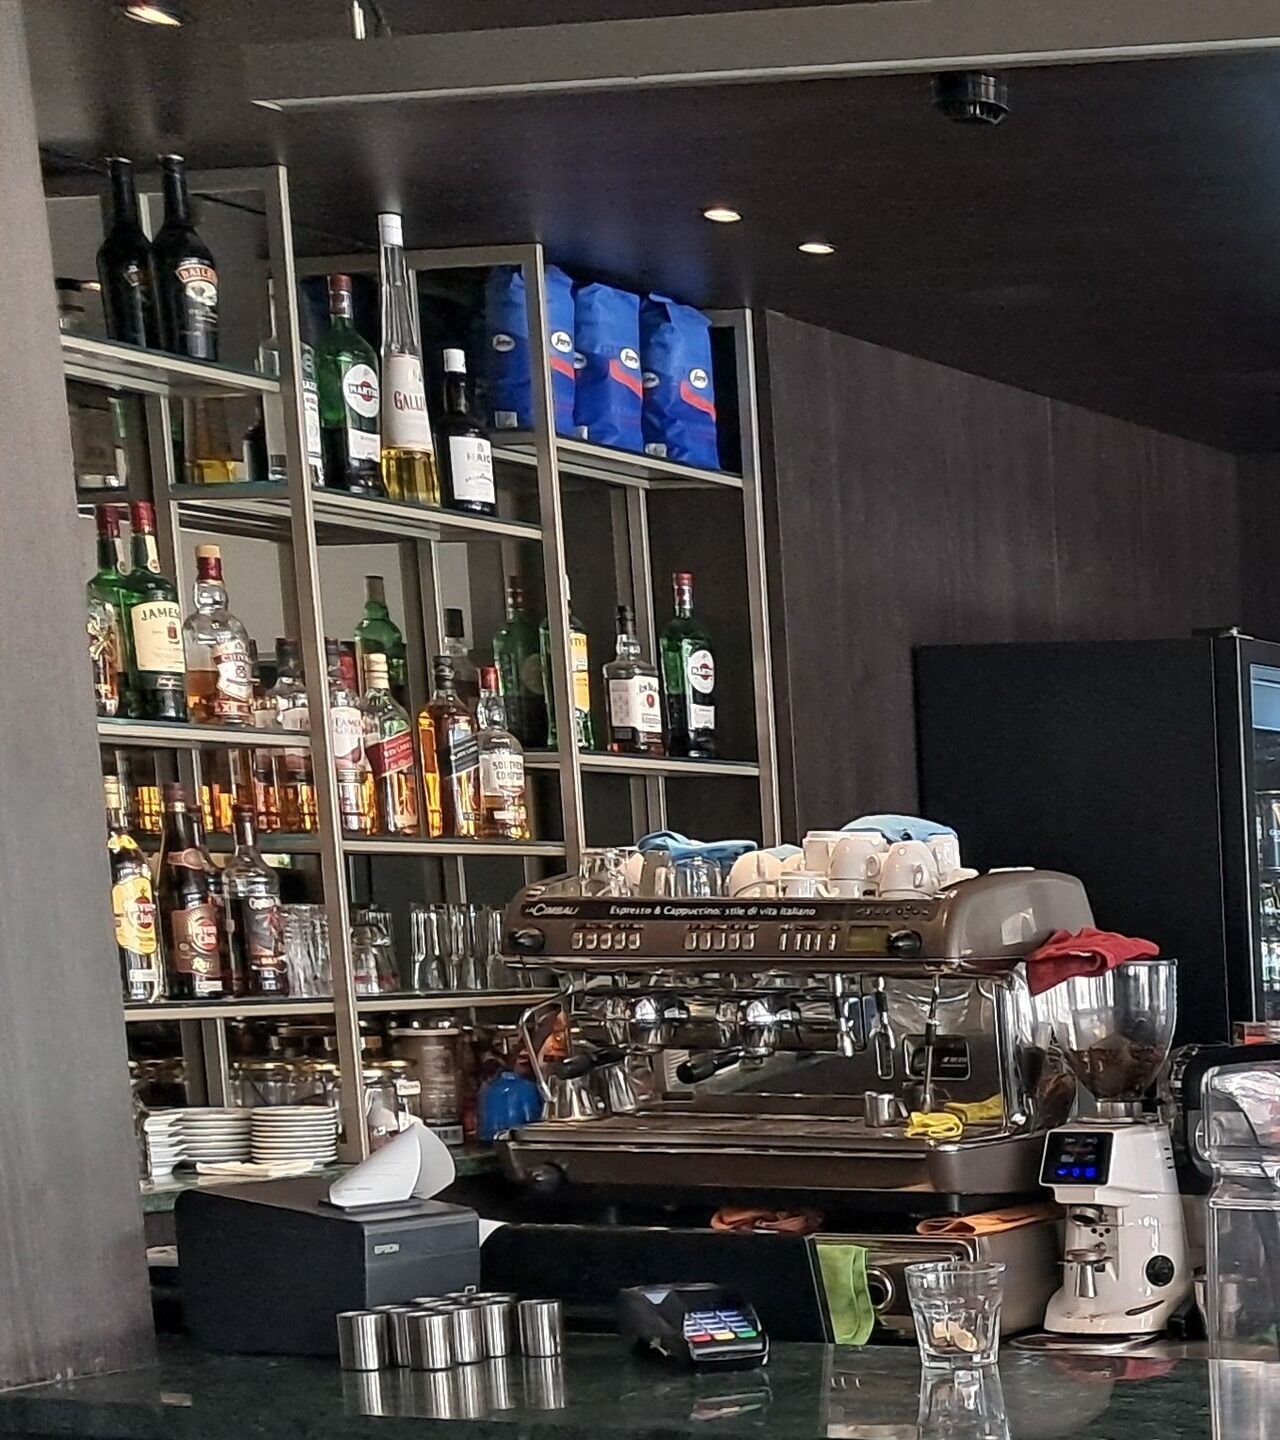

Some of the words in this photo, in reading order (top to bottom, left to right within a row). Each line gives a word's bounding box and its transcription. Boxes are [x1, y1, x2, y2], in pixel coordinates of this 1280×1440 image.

[609, 904, 652, 916] Espresso
[653, 905, 661, 915] &
[746, 905, 758, 916] di
[760, 906, 778, 916] vita
